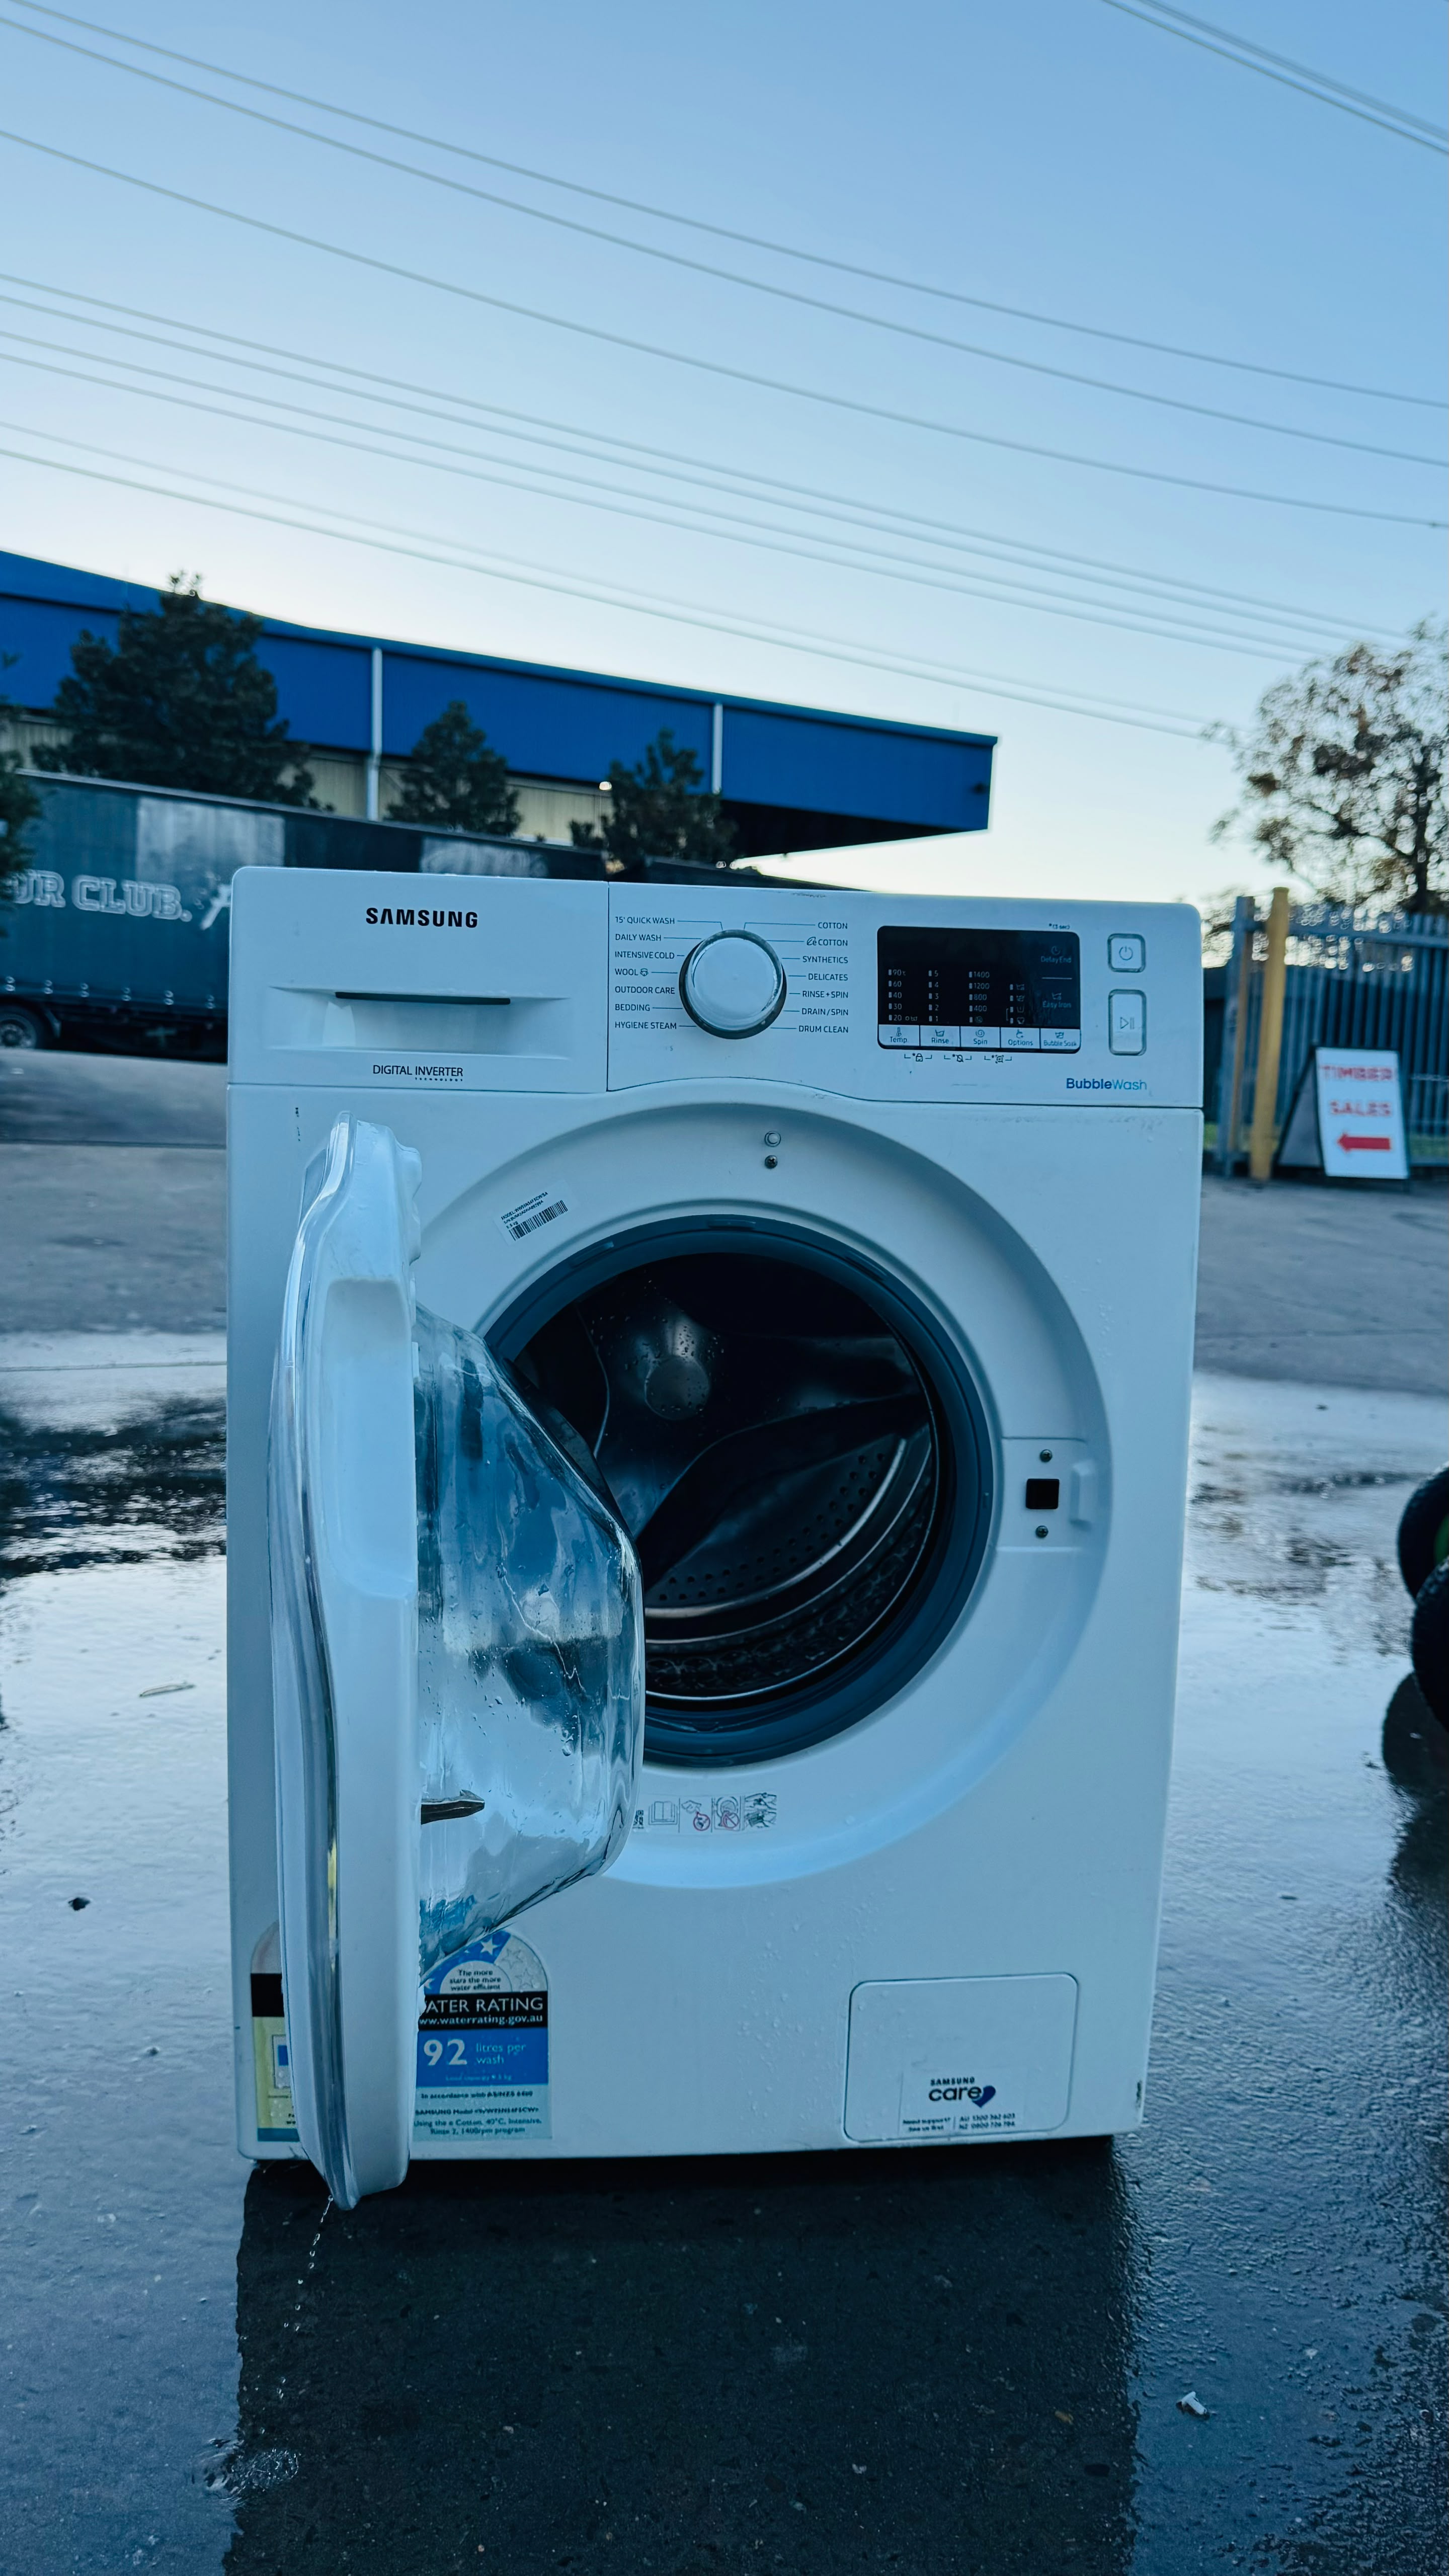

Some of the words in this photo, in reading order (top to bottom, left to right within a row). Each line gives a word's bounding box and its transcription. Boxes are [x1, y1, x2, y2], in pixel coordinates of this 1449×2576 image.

[71, 875, 192, 922] CLUB.
[366, 907, 477, 928] SAMSUNG
[1042, 1001, 1057, 1009] Easy
[373, 1065, 413, 1075] DIGITAL
[415, 1066, 463, 1077] INVERTER
[1321, 1065, 1393, 1081] TIMBER
[1066, 1078, 1147, 1090] BubbleWash
[1329, 1100, 1392, 1117] SALES
[425, 1999, 470, 2013] ATER
[476, 1997, 543, 2012] RATING
[424, 2039, 467, 2066] 92
[476, 2043, 503, 2053] litres
[507, 2044, 526, 2055] per
[475, 2055, 504, 2064] wash
[931, 2077, 975, 2086] SAMSUNG
[929, 2086, 982, 2102] care
